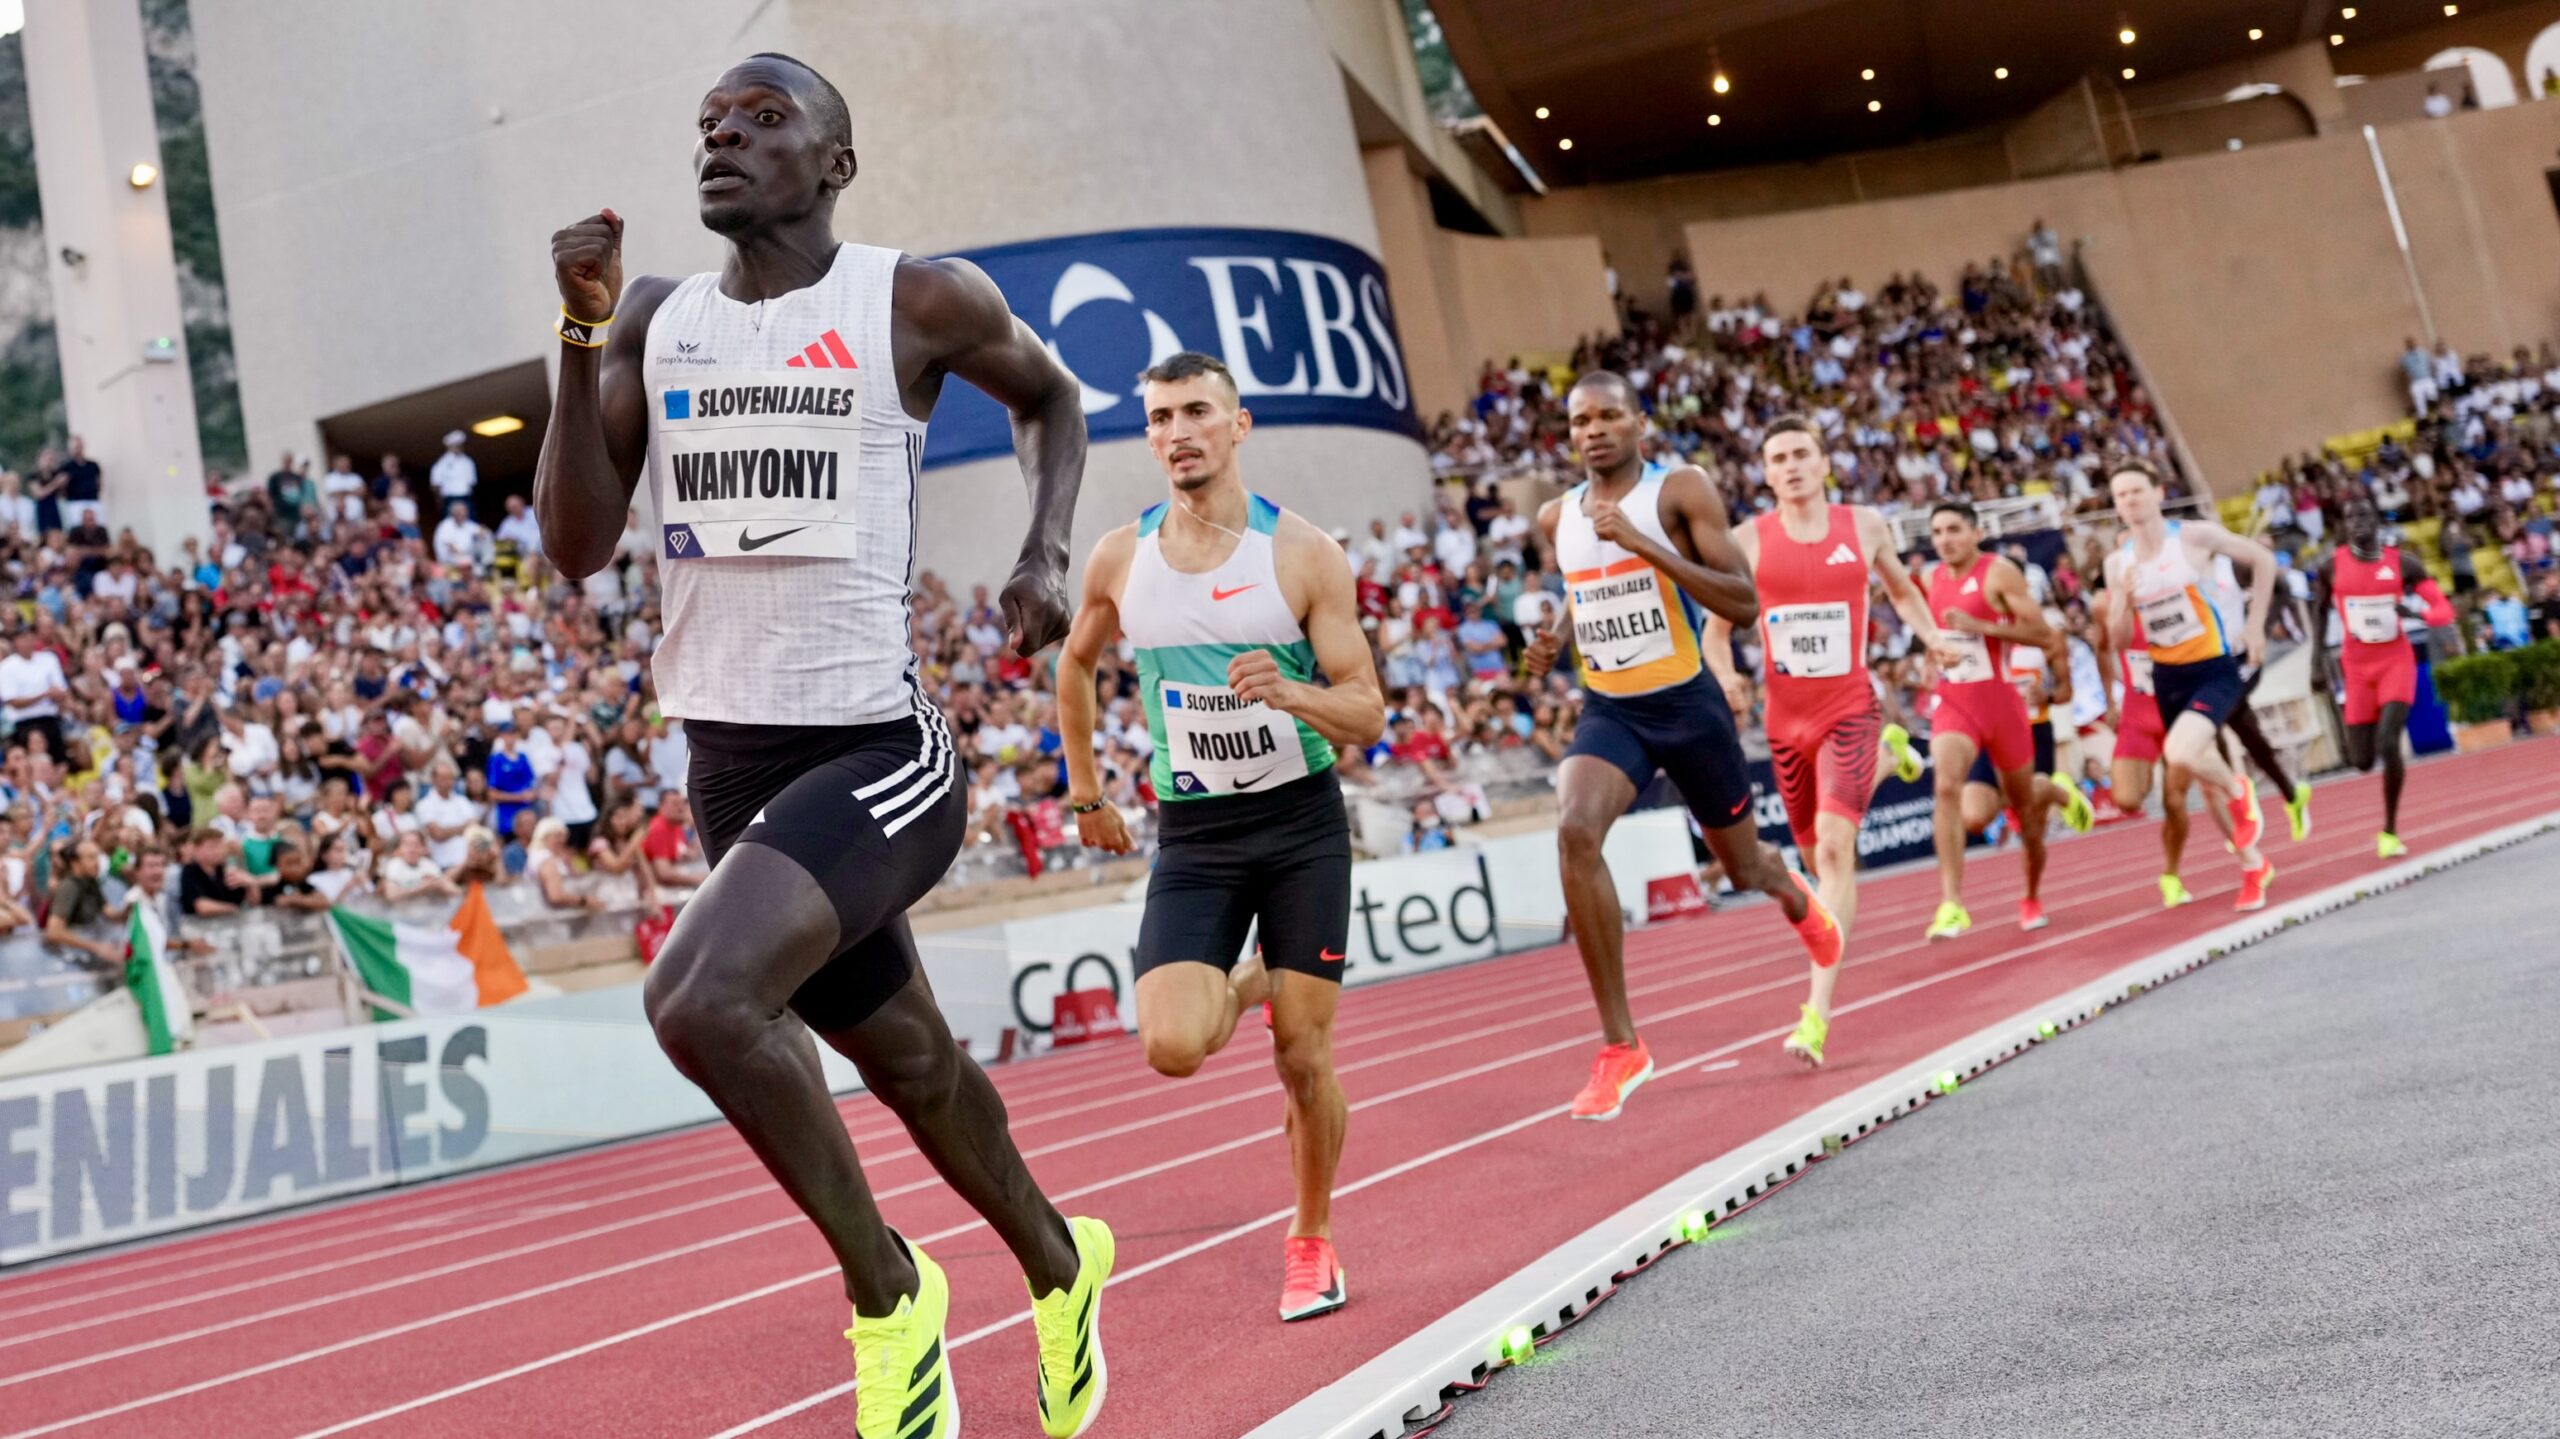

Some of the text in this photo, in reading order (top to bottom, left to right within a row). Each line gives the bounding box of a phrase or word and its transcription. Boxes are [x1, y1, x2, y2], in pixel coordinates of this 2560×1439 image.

[1188, 256, 1407, 410] EBS
[684, 356, 718, 367] Angels
[697, 385, 854, 417] SLOVENIJALES
[672, 448, 838, 502] WANYONYI
[1577, 608, 1666, 645] MASALELA
[1791, 635, 1829, 654] HOEY
[1187, 693, 1264, 712] SLOVENI
[1188, 724, 1278, 762] MOULA
[0, 1024, 490, 1252] ENIJALES
